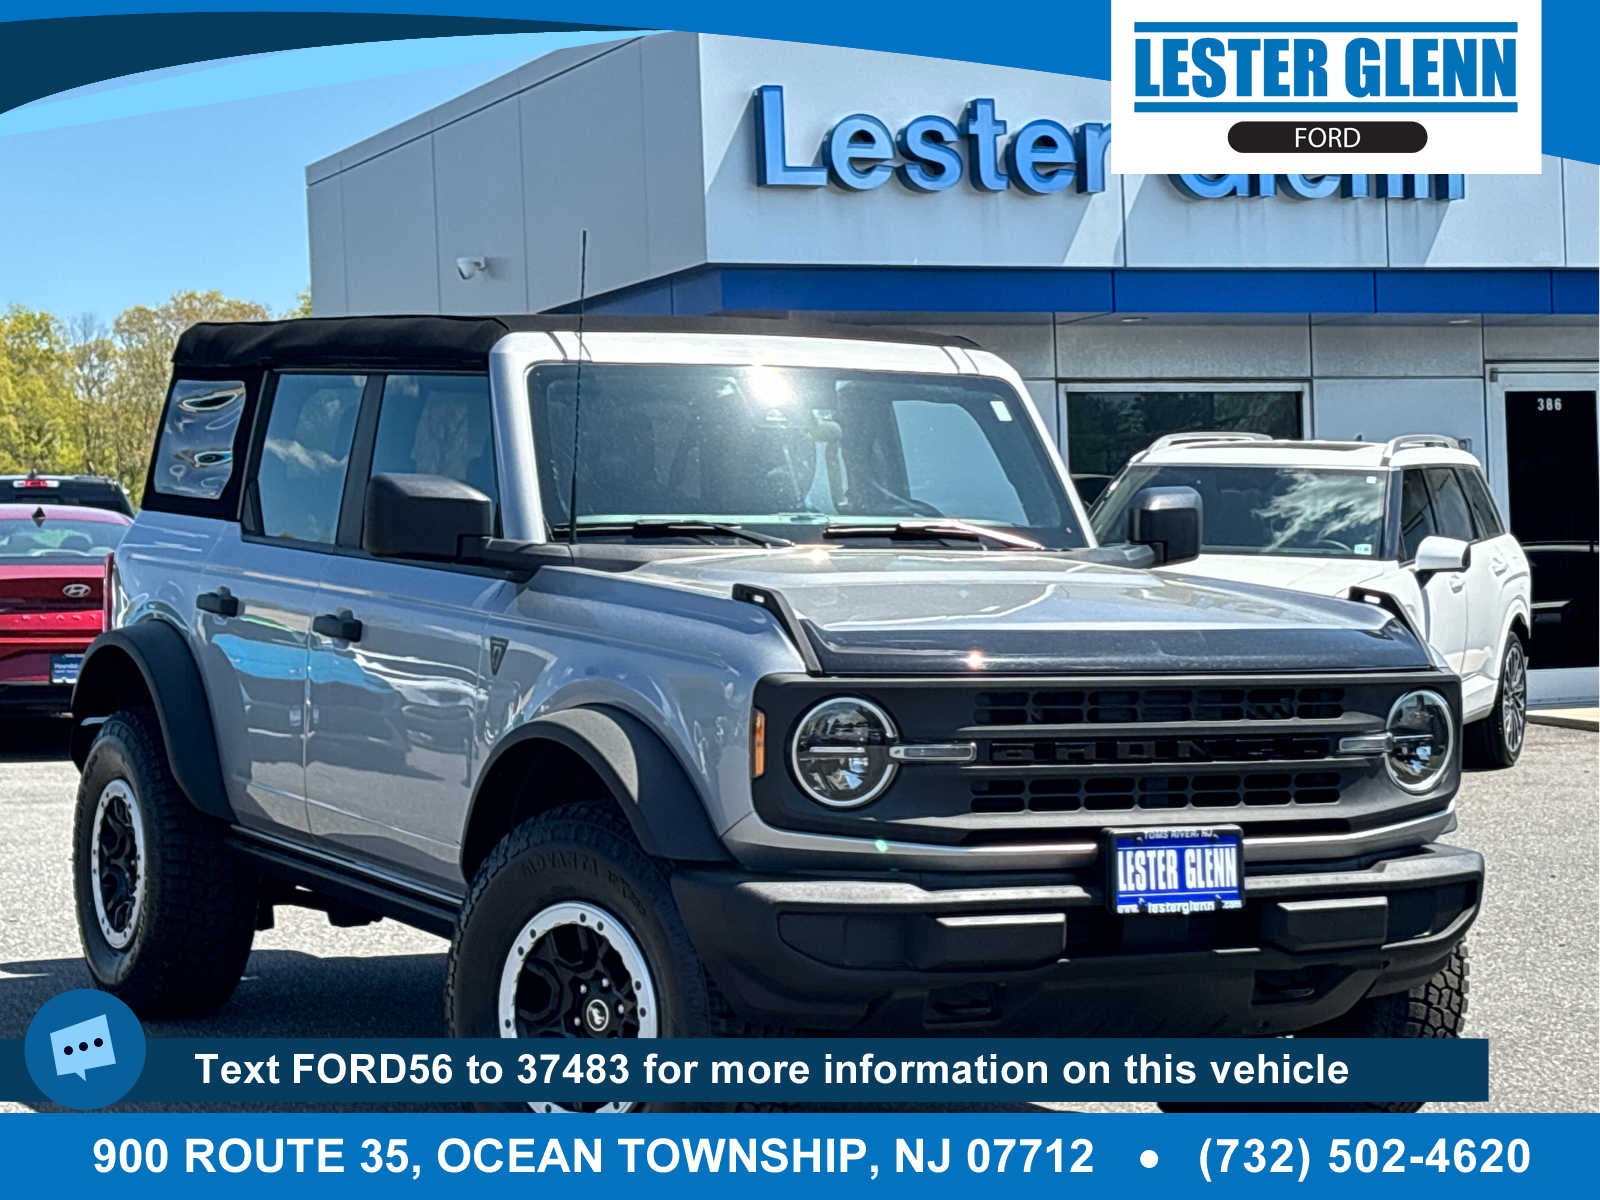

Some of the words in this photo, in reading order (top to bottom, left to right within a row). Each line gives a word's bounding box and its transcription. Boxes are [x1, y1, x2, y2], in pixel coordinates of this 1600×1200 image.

[753, 84, 1112, 194] Lester
[1536, 397, 1563, 412] 386
[1118, 850, 1179, 891] LESTER
[1185, 848, 1238, 888] GLENN
